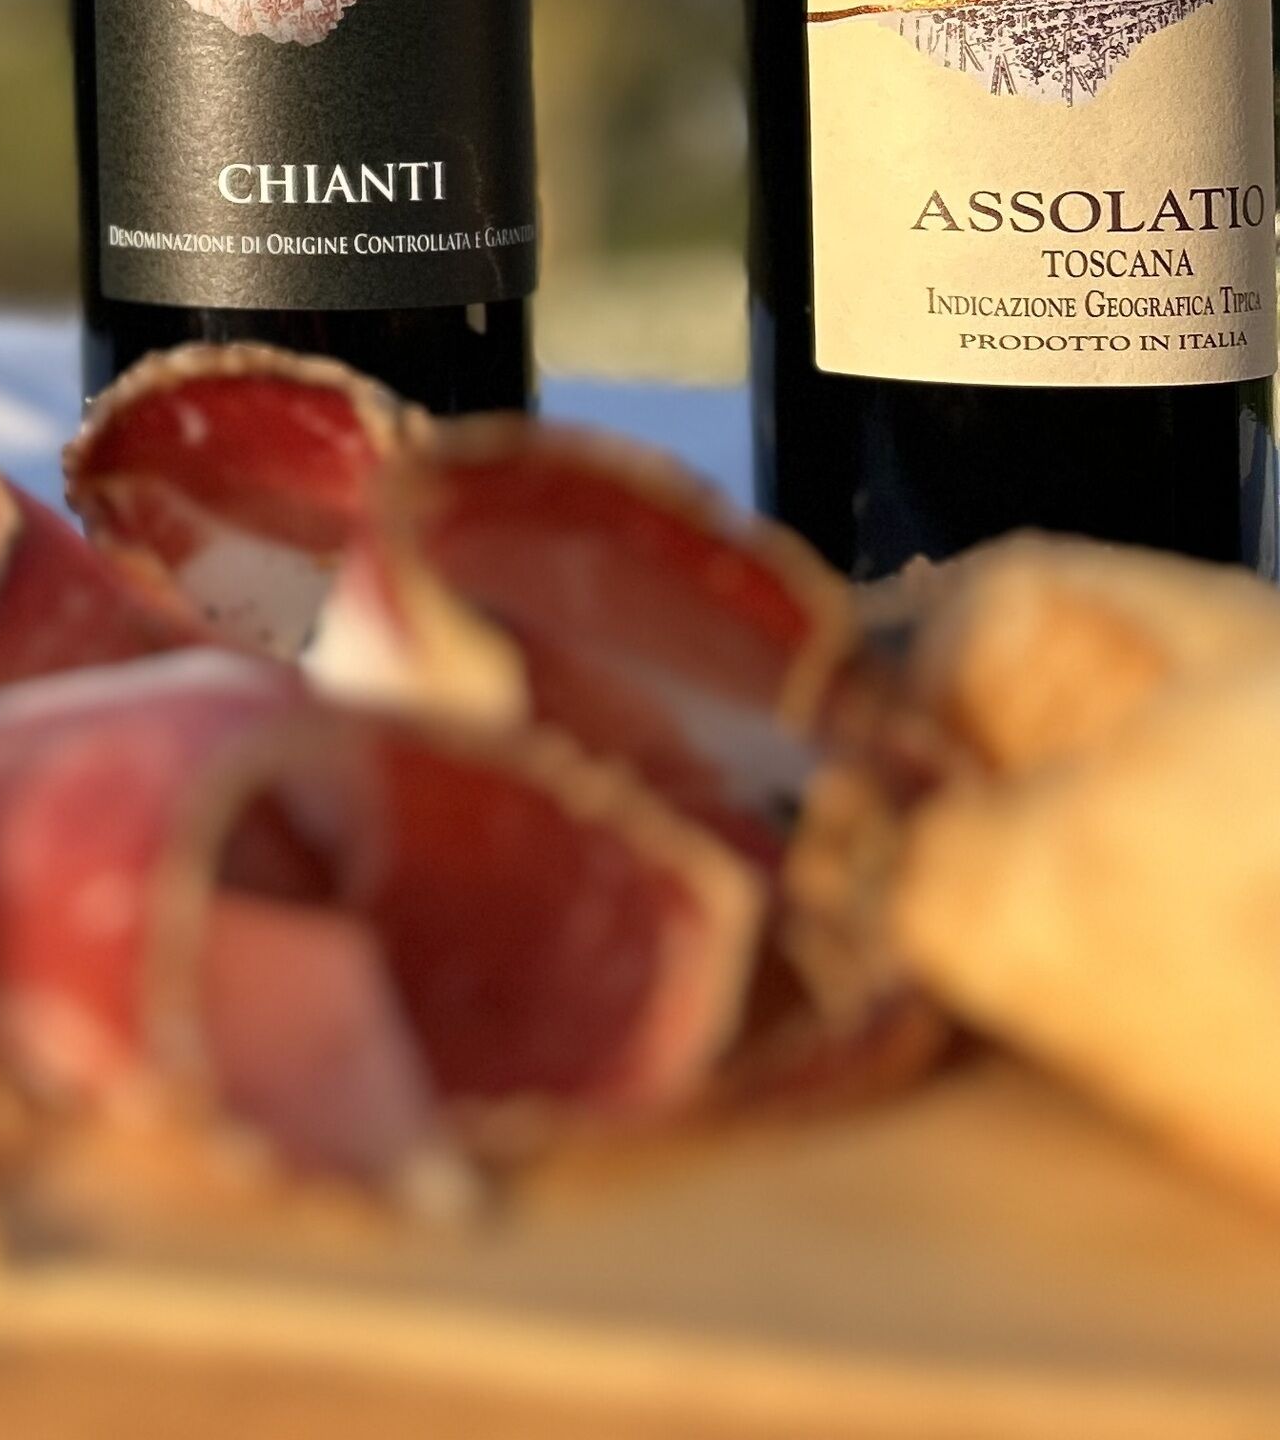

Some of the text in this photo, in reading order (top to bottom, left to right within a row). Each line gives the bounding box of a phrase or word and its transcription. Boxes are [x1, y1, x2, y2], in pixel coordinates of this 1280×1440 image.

[217, 161, 446, 205] CHIANTI
[911, 184, 1266, 233] ASSOLATIO
[108, 224, 235, 254] DENOMINAZIONE
[241, 235, 261, 254] DI
[266, 232, 348, 255] ORIGINE
[354, 232, 472, 254] CONTROLLATA
[475, 231, 482, 249] E
[1041, 248, 1194, 277] TOSCANA
[926, 285, 1262, 318] INDICAZIONE GEOGRAFICA TIPICA
[959, 331, 1248, 351] PRODOTTO IN ITALIA
